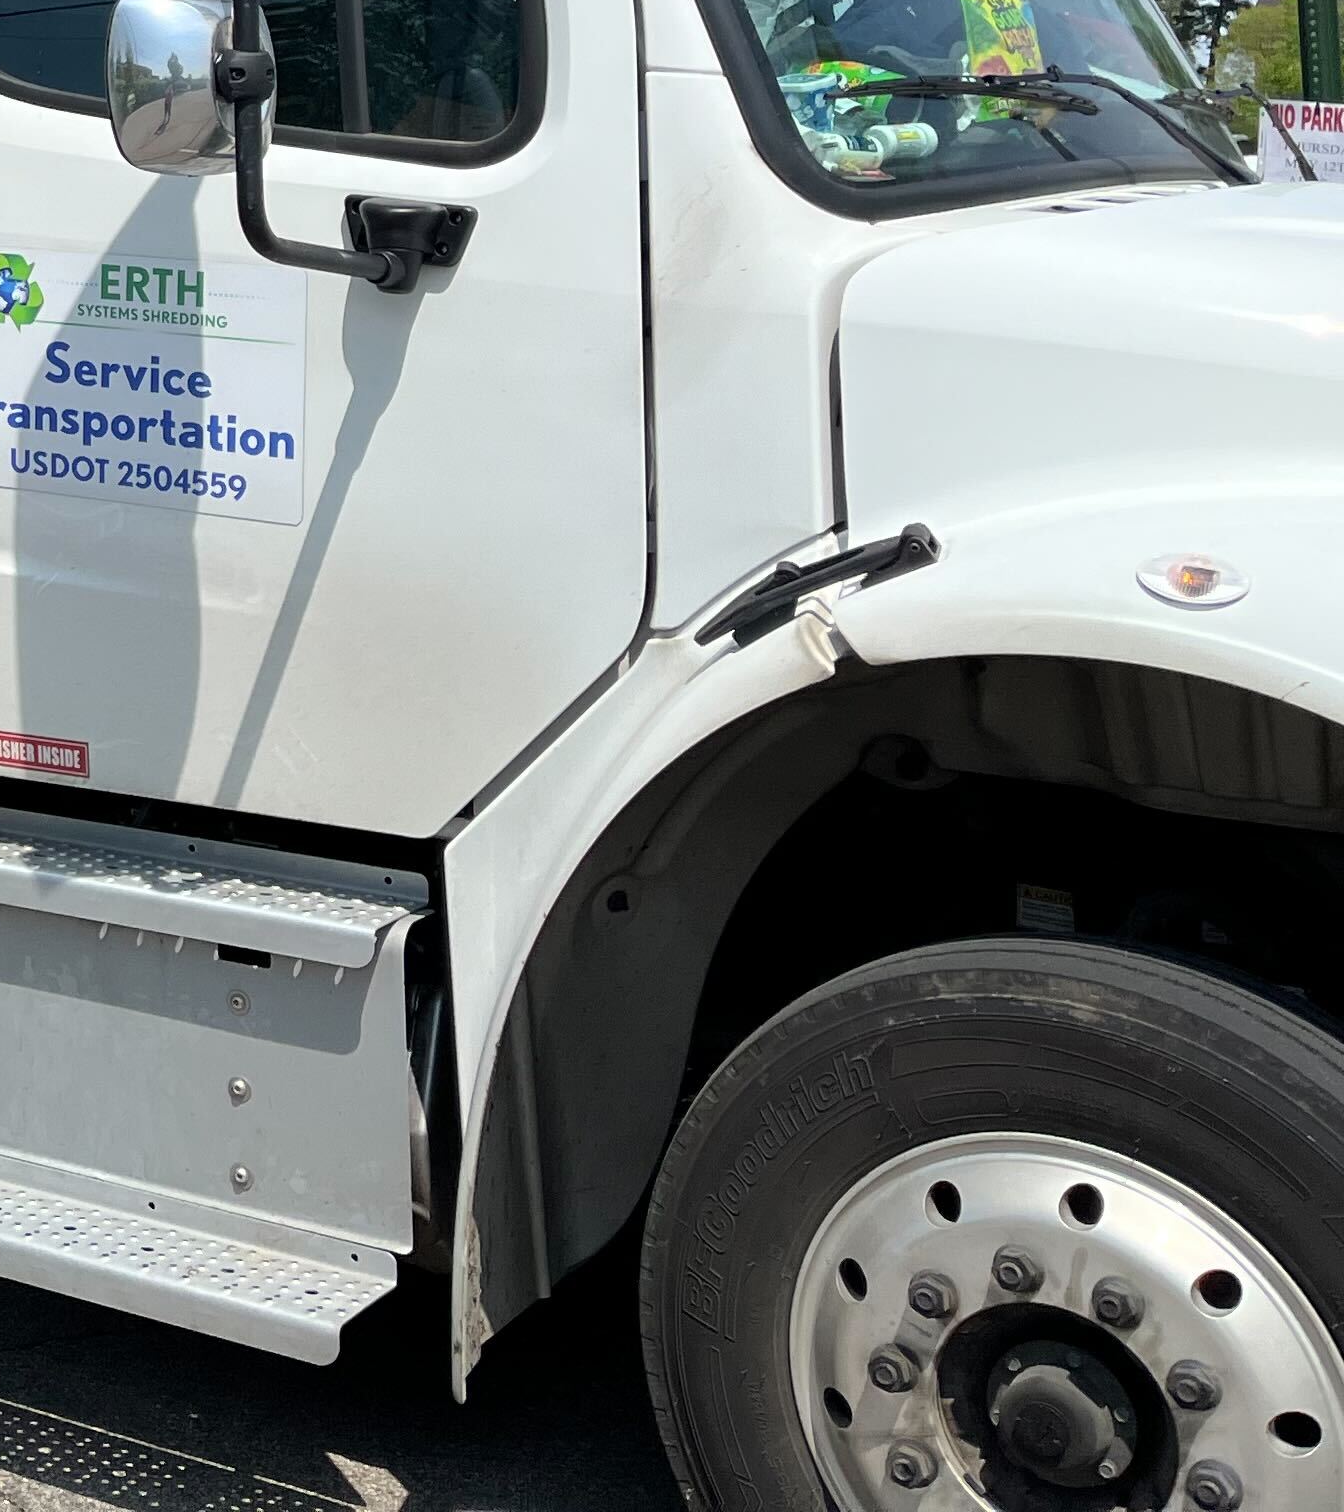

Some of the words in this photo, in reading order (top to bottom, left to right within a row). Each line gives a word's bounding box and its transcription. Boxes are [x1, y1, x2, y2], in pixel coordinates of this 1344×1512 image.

[1285, 158, 1318, 170] MY
[99, 263, 205, 309] ERTH
[77, 303, 140, 324] SYSTEMS
[142, 308, 229, 330] SHREDDING
[44, 341, 213, 399] Service
[10, 447, 110, 486] USDOT
[116, 460, 248, 503] 2504559
[36, 743, 82, 771] INSIDE
